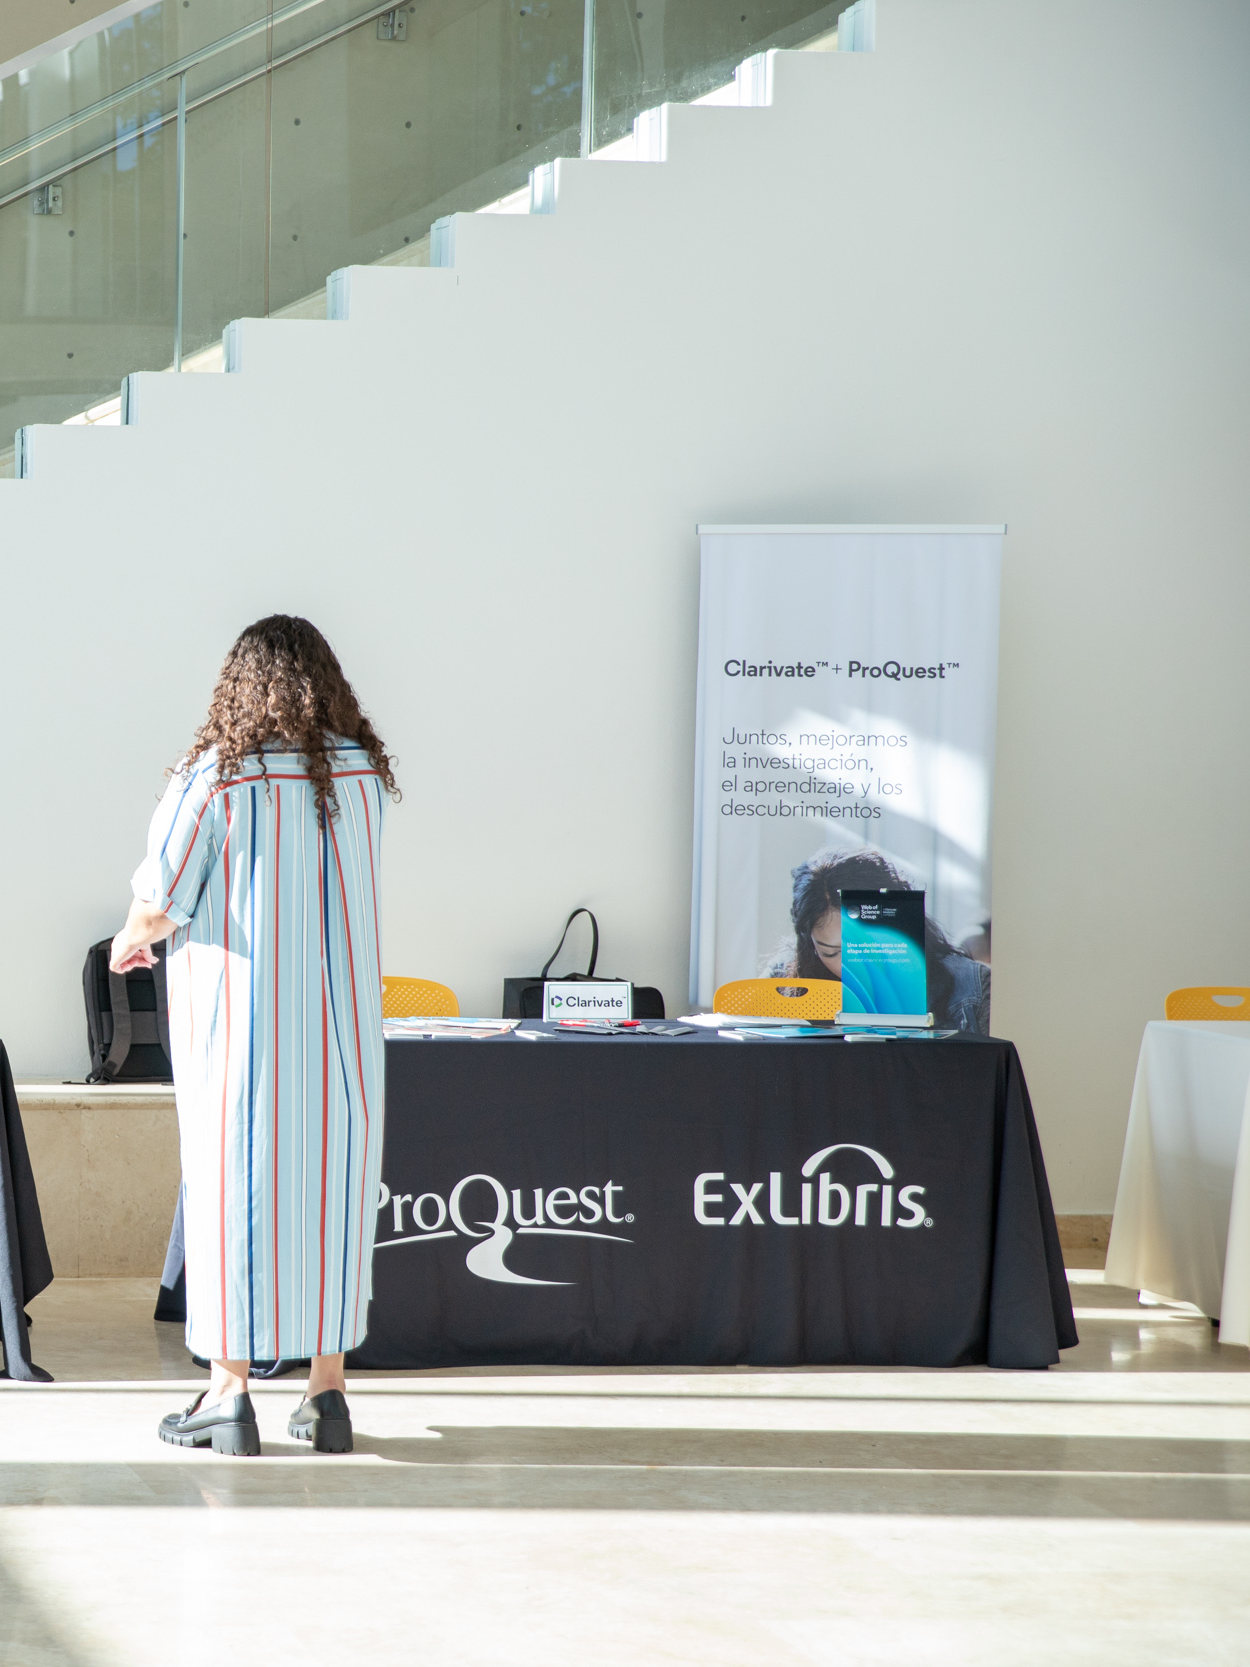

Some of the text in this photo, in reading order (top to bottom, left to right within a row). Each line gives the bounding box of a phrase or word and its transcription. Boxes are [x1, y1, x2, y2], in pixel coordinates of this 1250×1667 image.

[722, 727, 908, 750] Juntos, mejoramos
[722, 751, 874, 774] la investigación,
[721, 775, 903, 798] el aprendizaje y los
[721, 799, 881, 819] descubrimientos
